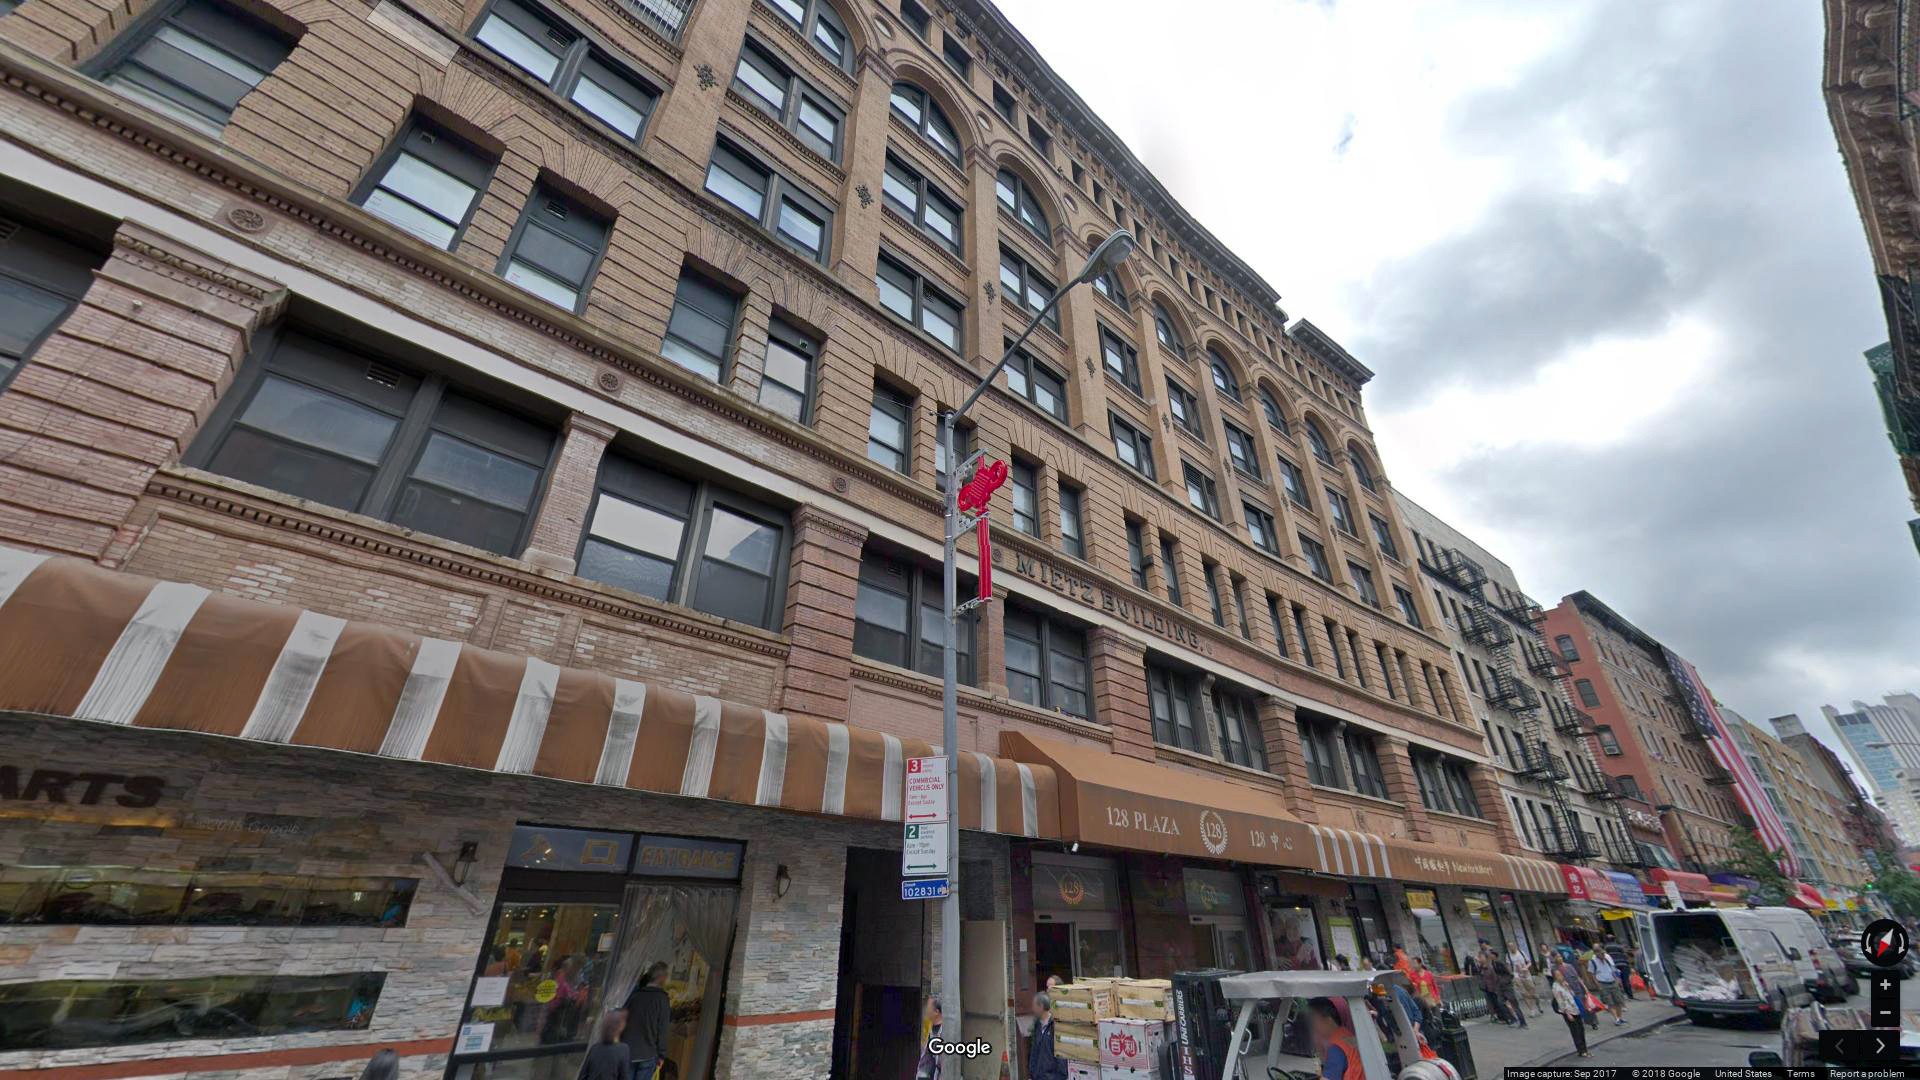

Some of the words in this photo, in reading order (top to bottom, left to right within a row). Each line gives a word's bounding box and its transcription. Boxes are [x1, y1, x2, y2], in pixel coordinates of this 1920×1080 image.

[1016, 552, 1095, 604] MIETZ
[911, 760, 919, 772] 3
[1106, 805, 1129, 828] 128
[1134, 811, 1181, 836] PLAZA
[908, 825, 916, 838] 2
[1205, 822, 1223, 839] 128
[1250, 830, 1266, 848] 128
[640, 845, 735, 870] ENTRANCE
[904, 886, 936, 898] 102831
